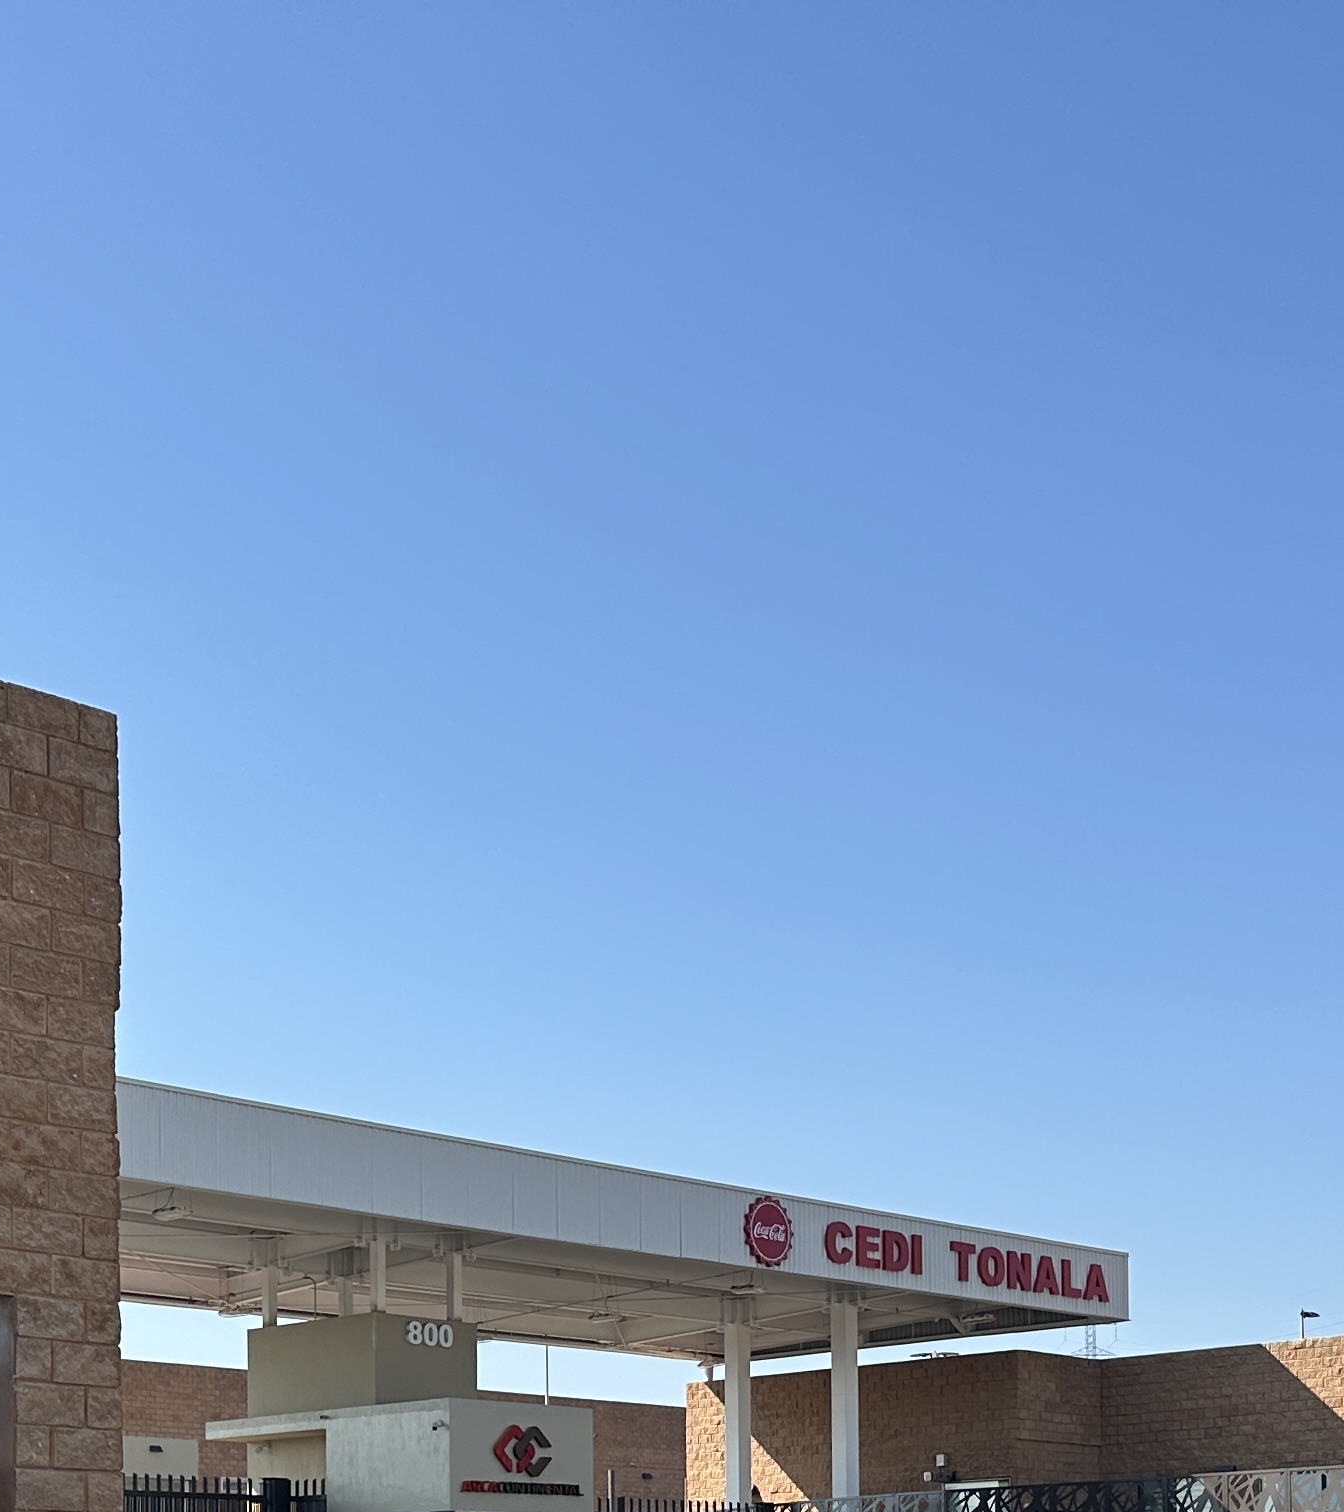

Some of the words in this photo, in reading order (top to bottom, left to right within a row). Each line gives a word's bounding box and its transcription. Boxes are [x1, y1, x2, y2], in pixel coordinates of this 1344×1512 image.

[824, 1221, 923, 1275] CEDI
[949, 1240, 1110, 1303] TONALA
[406, 1320, 454, 1348] 800
